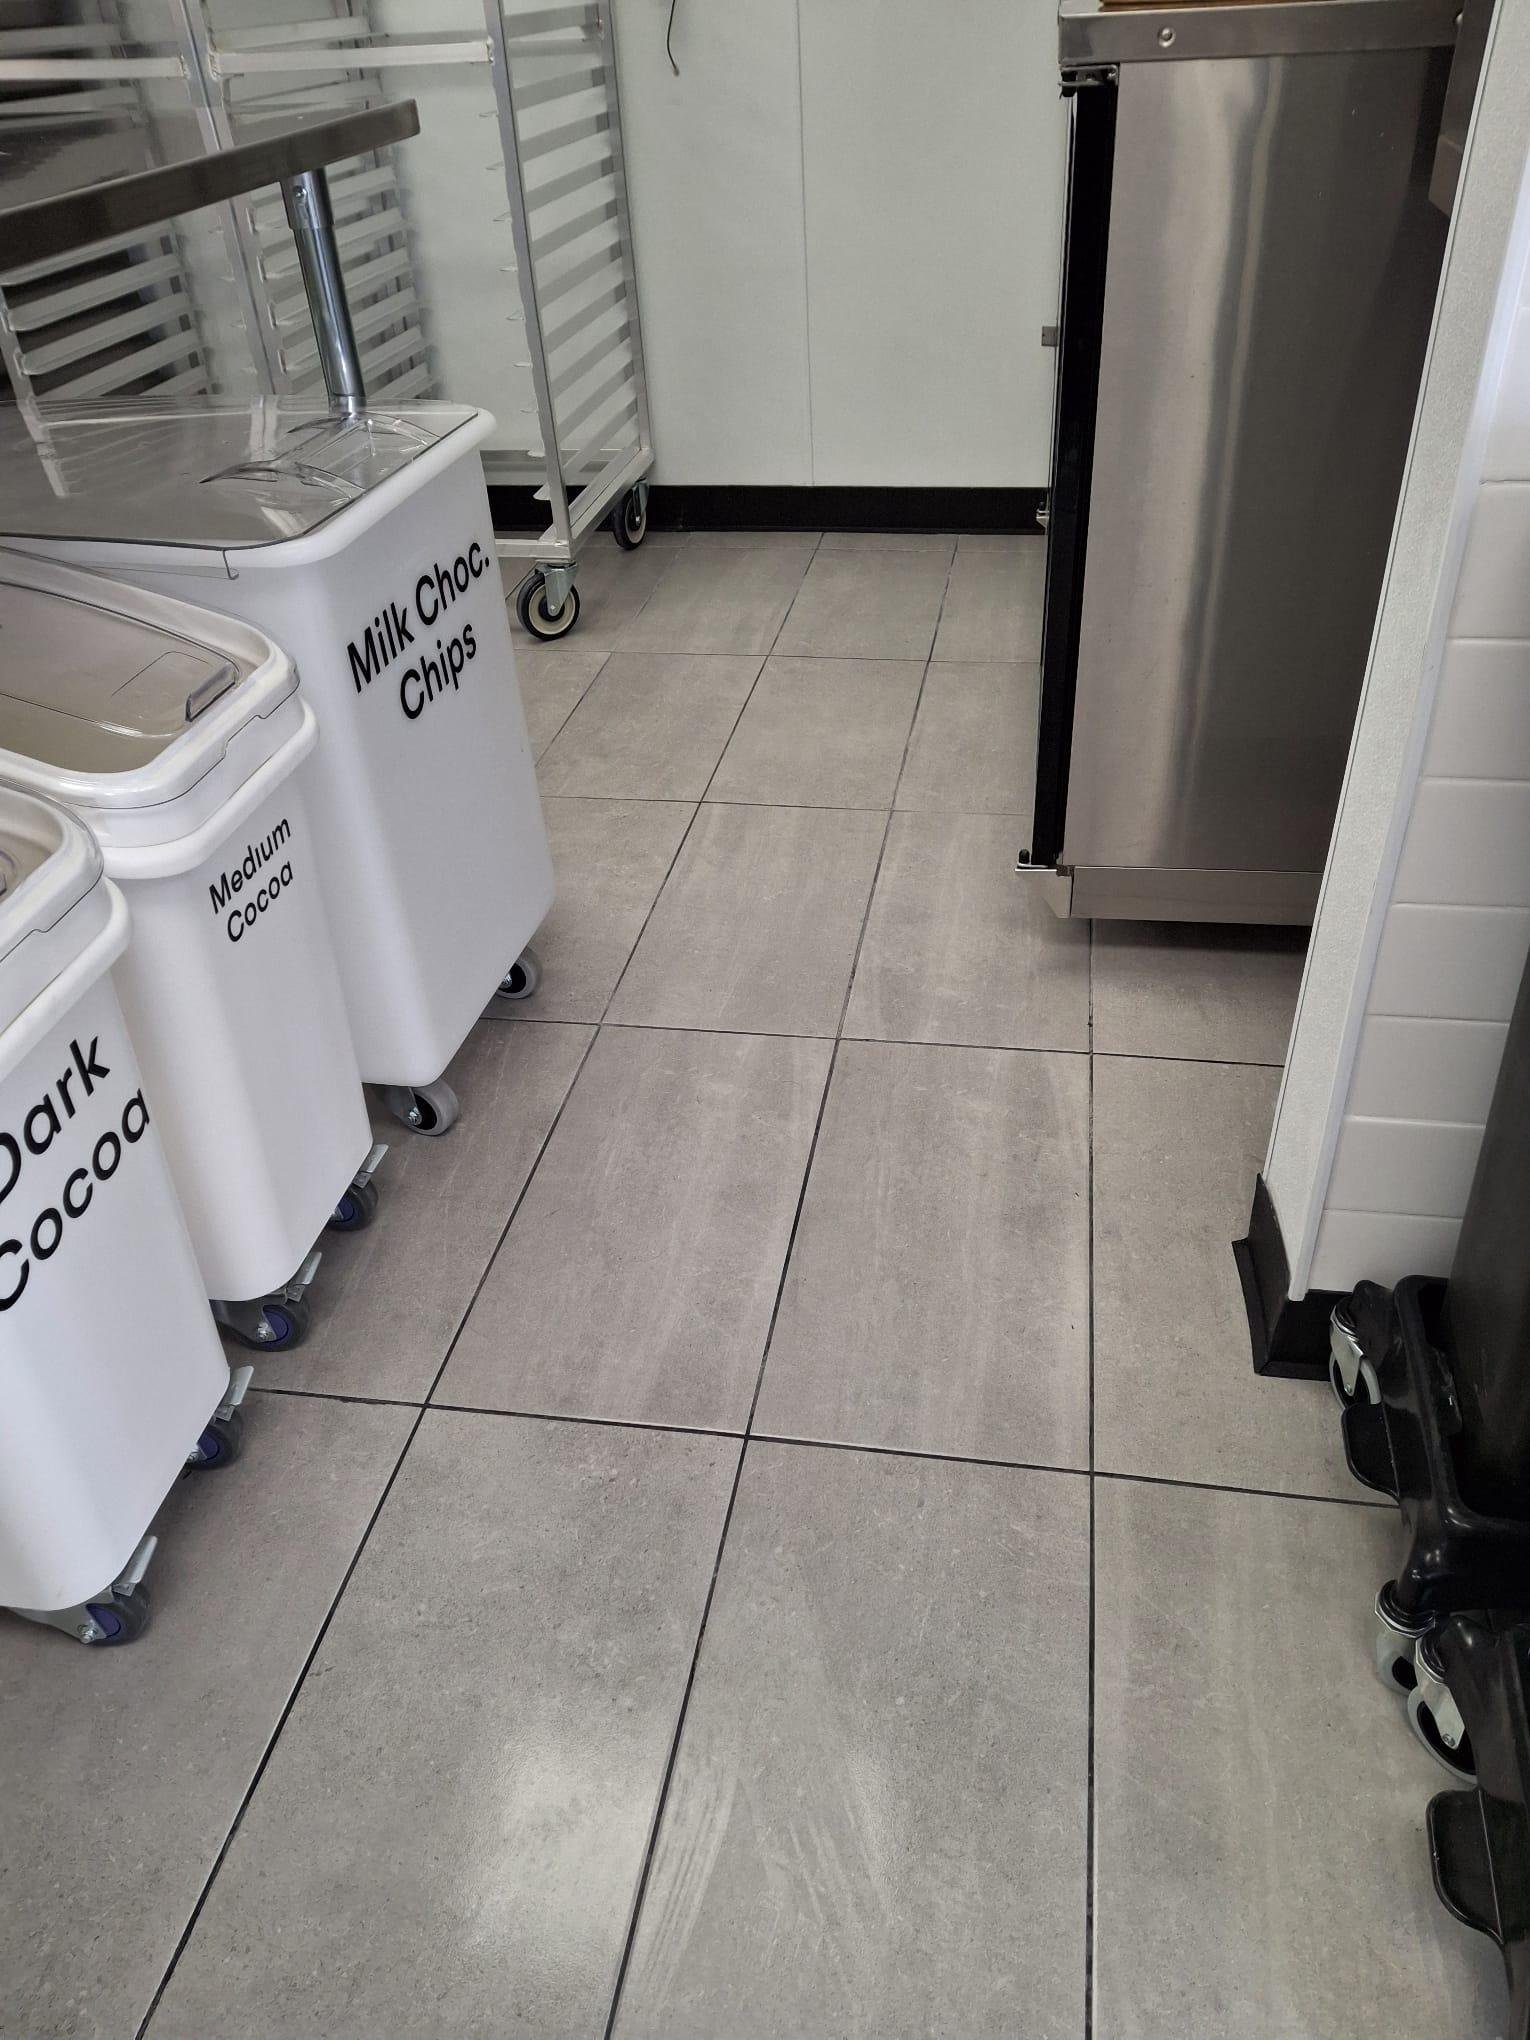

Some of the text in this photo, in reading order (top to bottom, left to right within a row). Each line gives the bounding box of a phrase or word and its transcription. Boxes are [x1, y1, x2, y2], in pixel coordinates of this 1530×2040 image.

[346, 542, 490, 694] Milk Choc.
[400, 623, 477, 720] Chips
[227, 860, 294, 943] Cocoa
[0, 1087, 150, 1312] Cocoa
